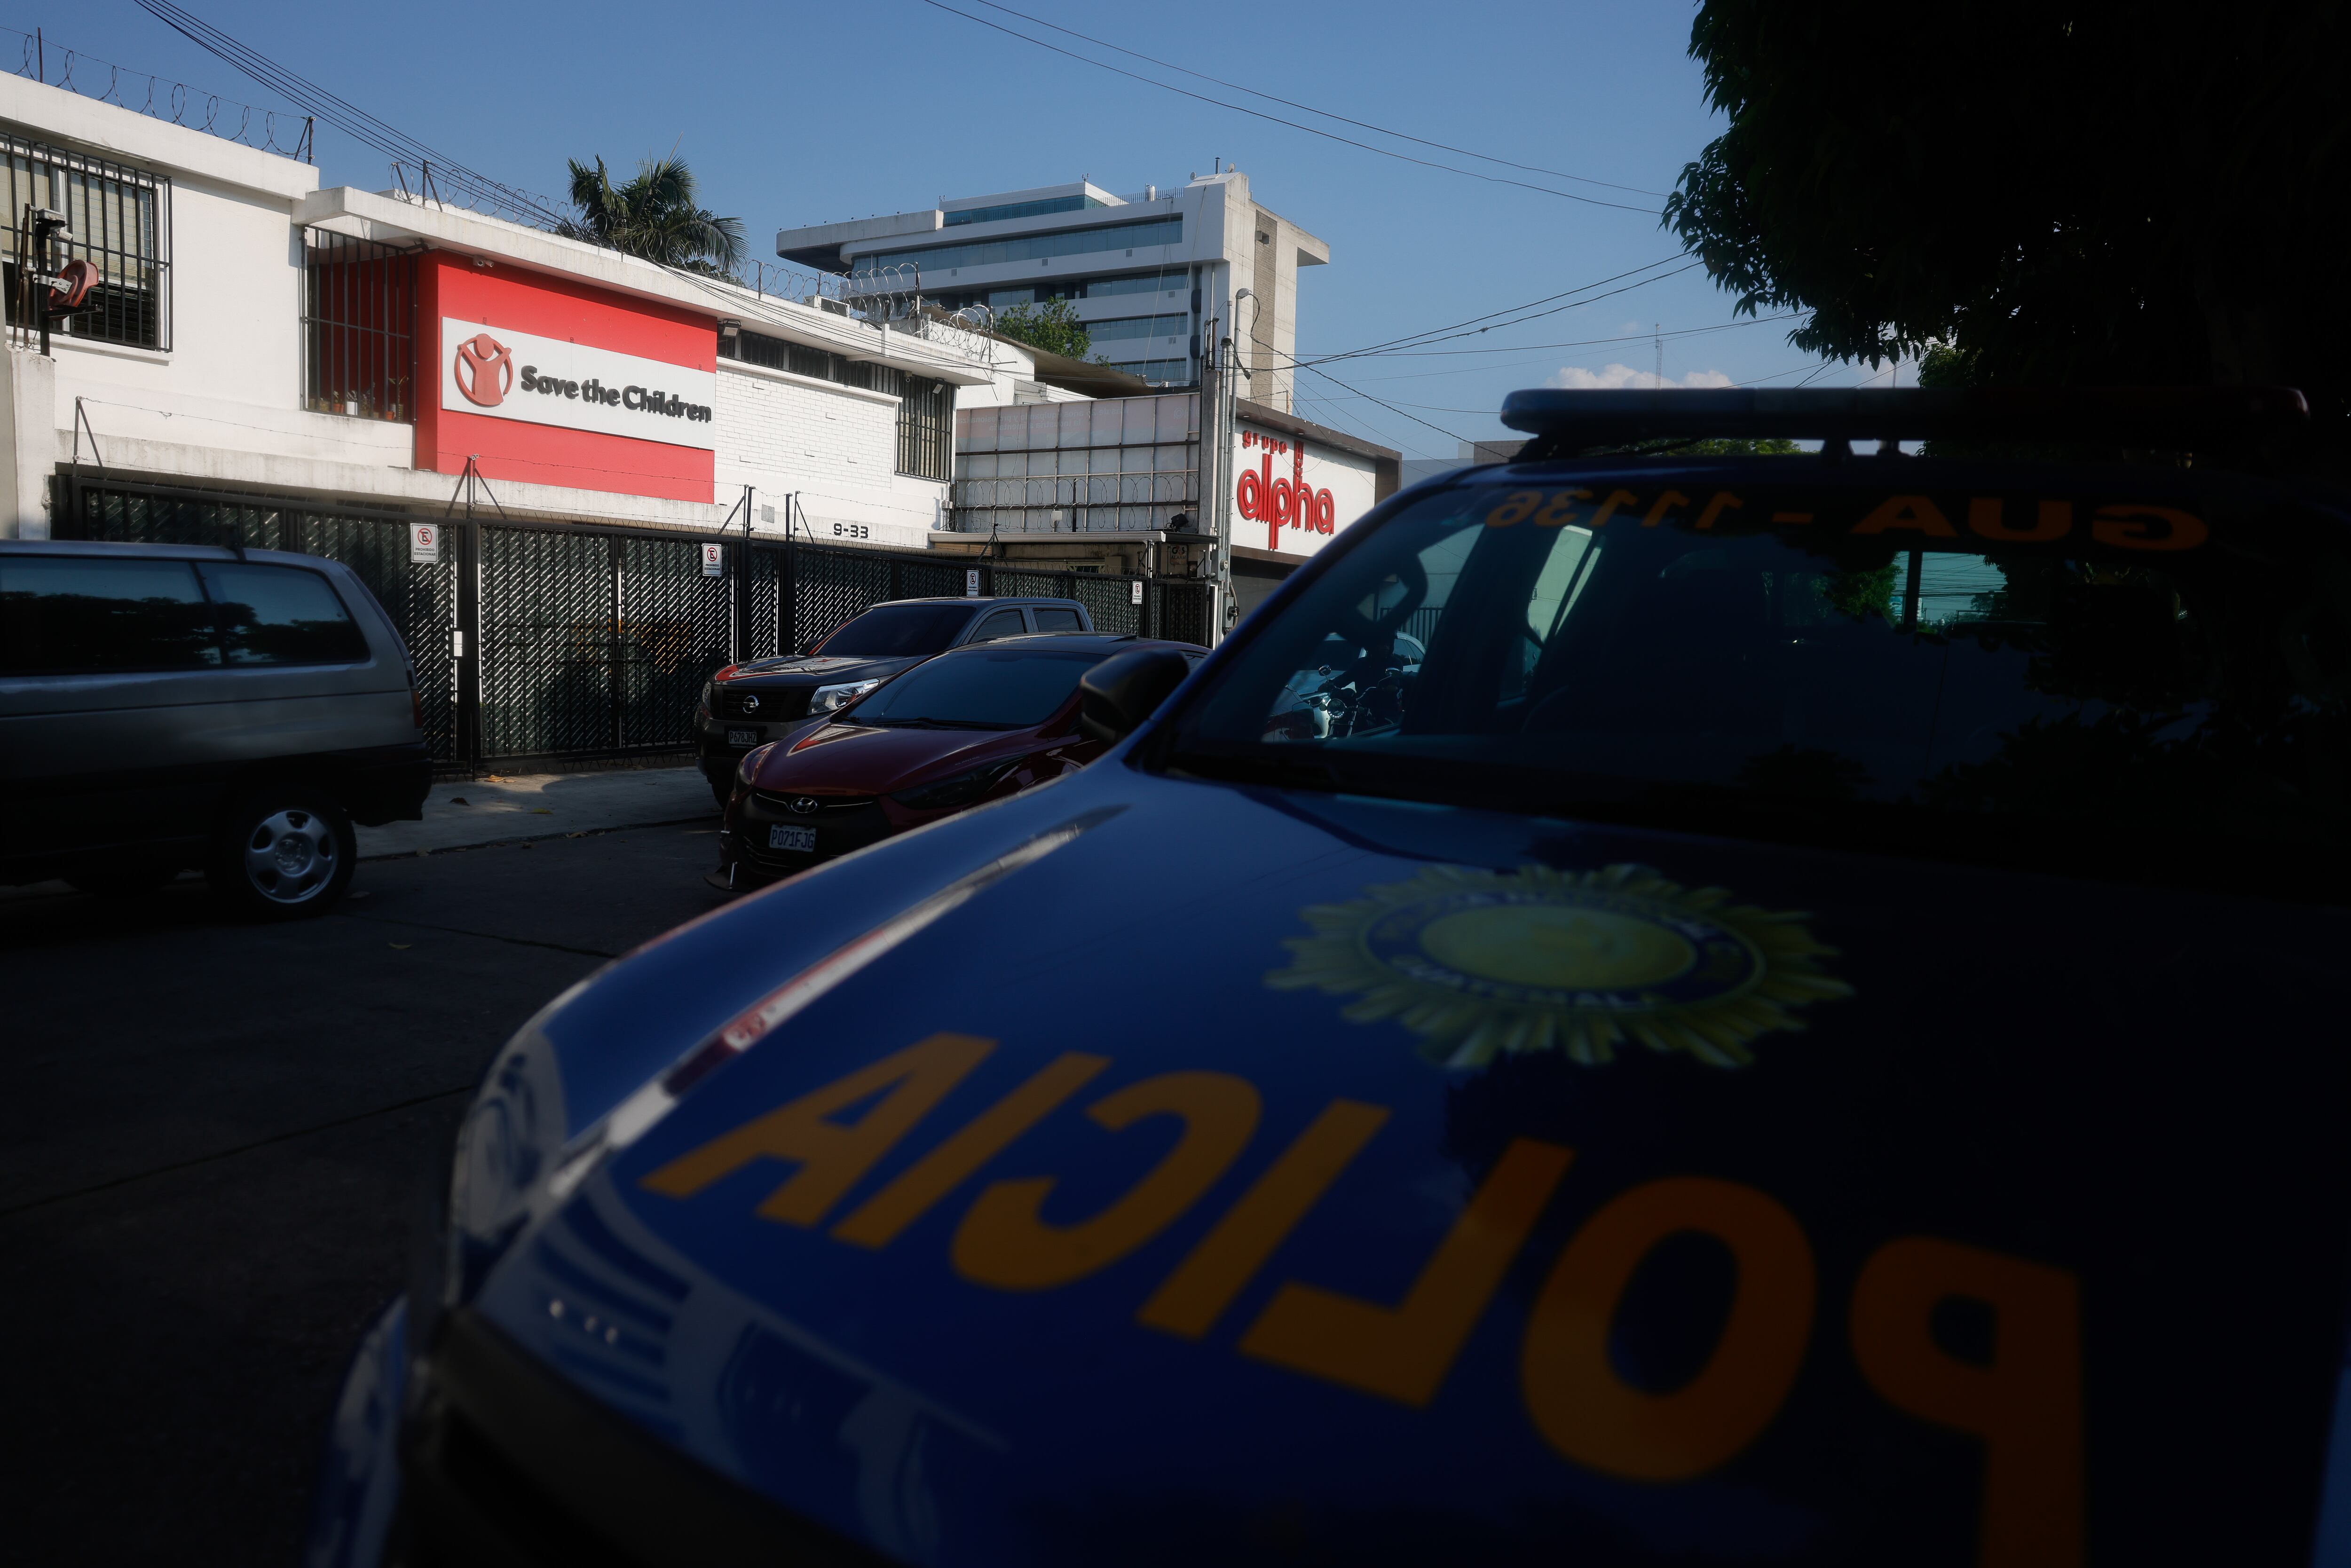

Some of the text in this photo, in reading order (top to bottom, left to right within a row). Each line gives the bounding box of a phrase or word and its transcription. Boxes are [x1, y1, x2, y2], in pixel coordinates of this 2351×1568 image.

[521, 365, 711, 423] Save the Children
[1242, 430, 1287, 455] grupo
[1237, 440, 1334, 551] alpha
[834, 523, 868, 539] 9-33
[730, 732, 757, 743] P678JHZ
[771, 829, 814, 848] P071FJG
